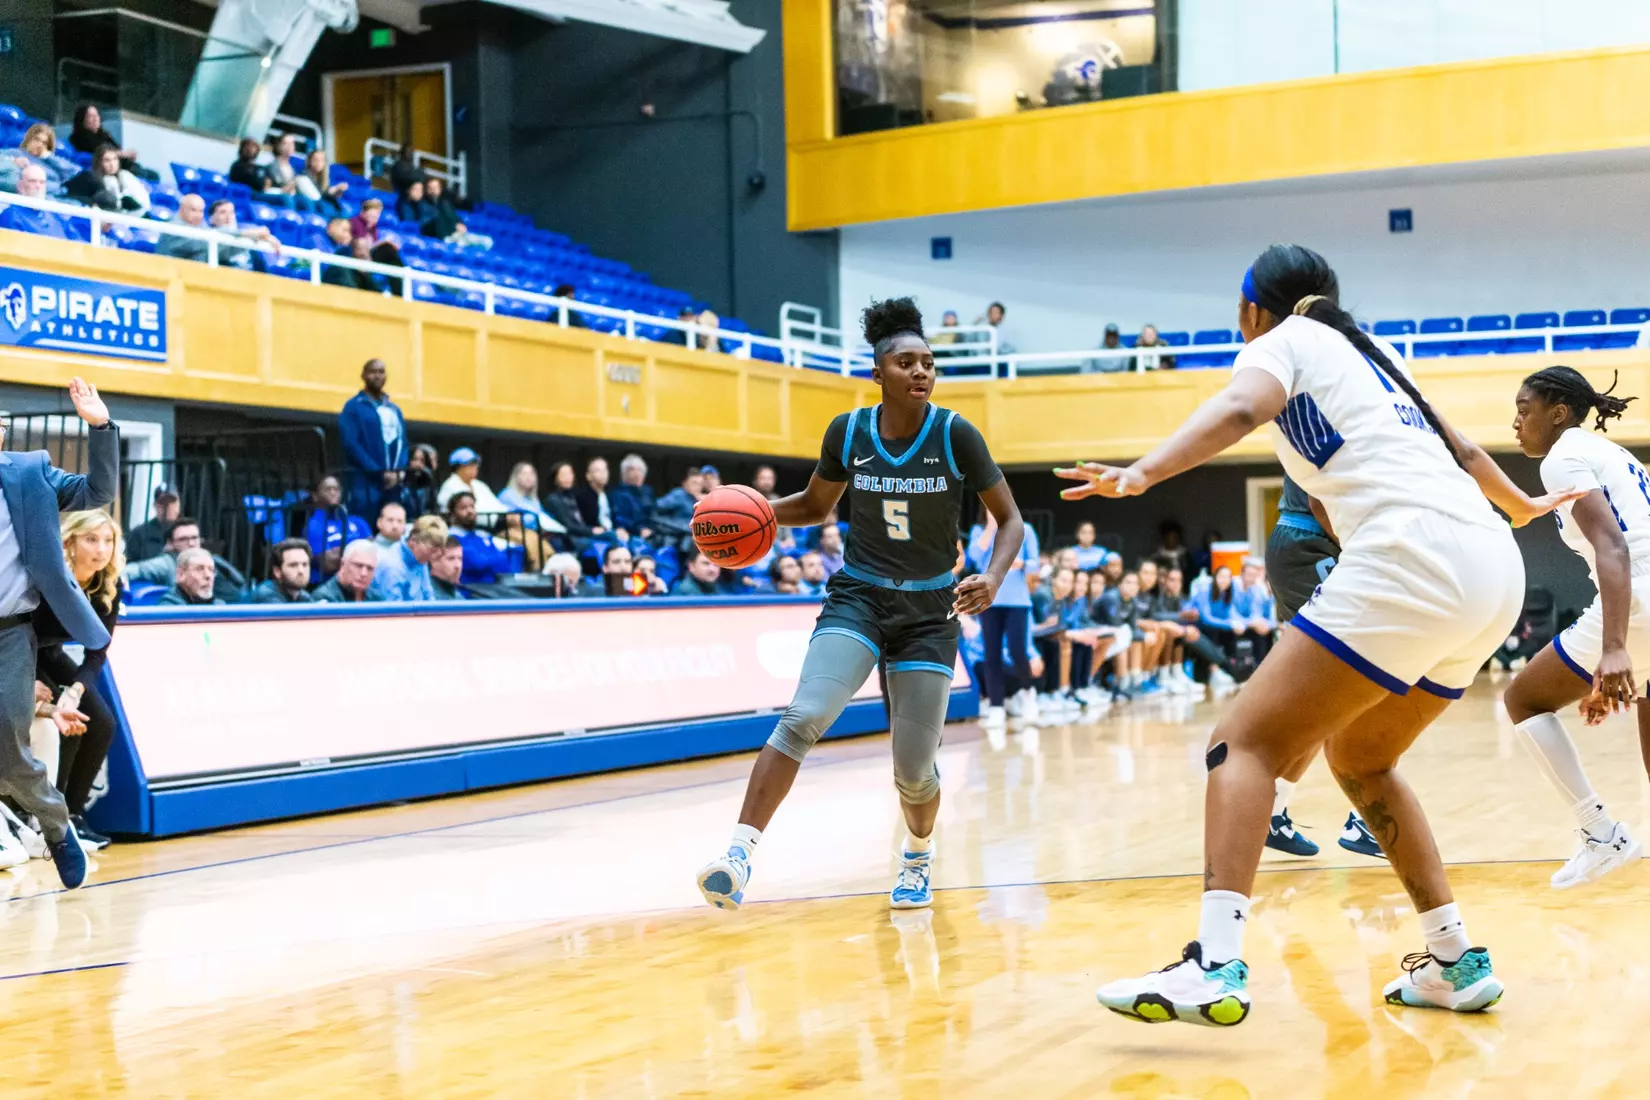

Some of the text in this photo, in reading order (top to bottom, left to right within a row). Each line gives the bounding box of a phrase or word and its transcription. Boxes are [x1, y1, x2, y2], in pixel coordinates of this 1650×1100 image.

[31, 285, 160, 331] PIRATE
[30, 320, 159, 347] ATHLETICS
[853, 473, 948, 494] COLUMBIA
[882, 499, 912, 541] 5
